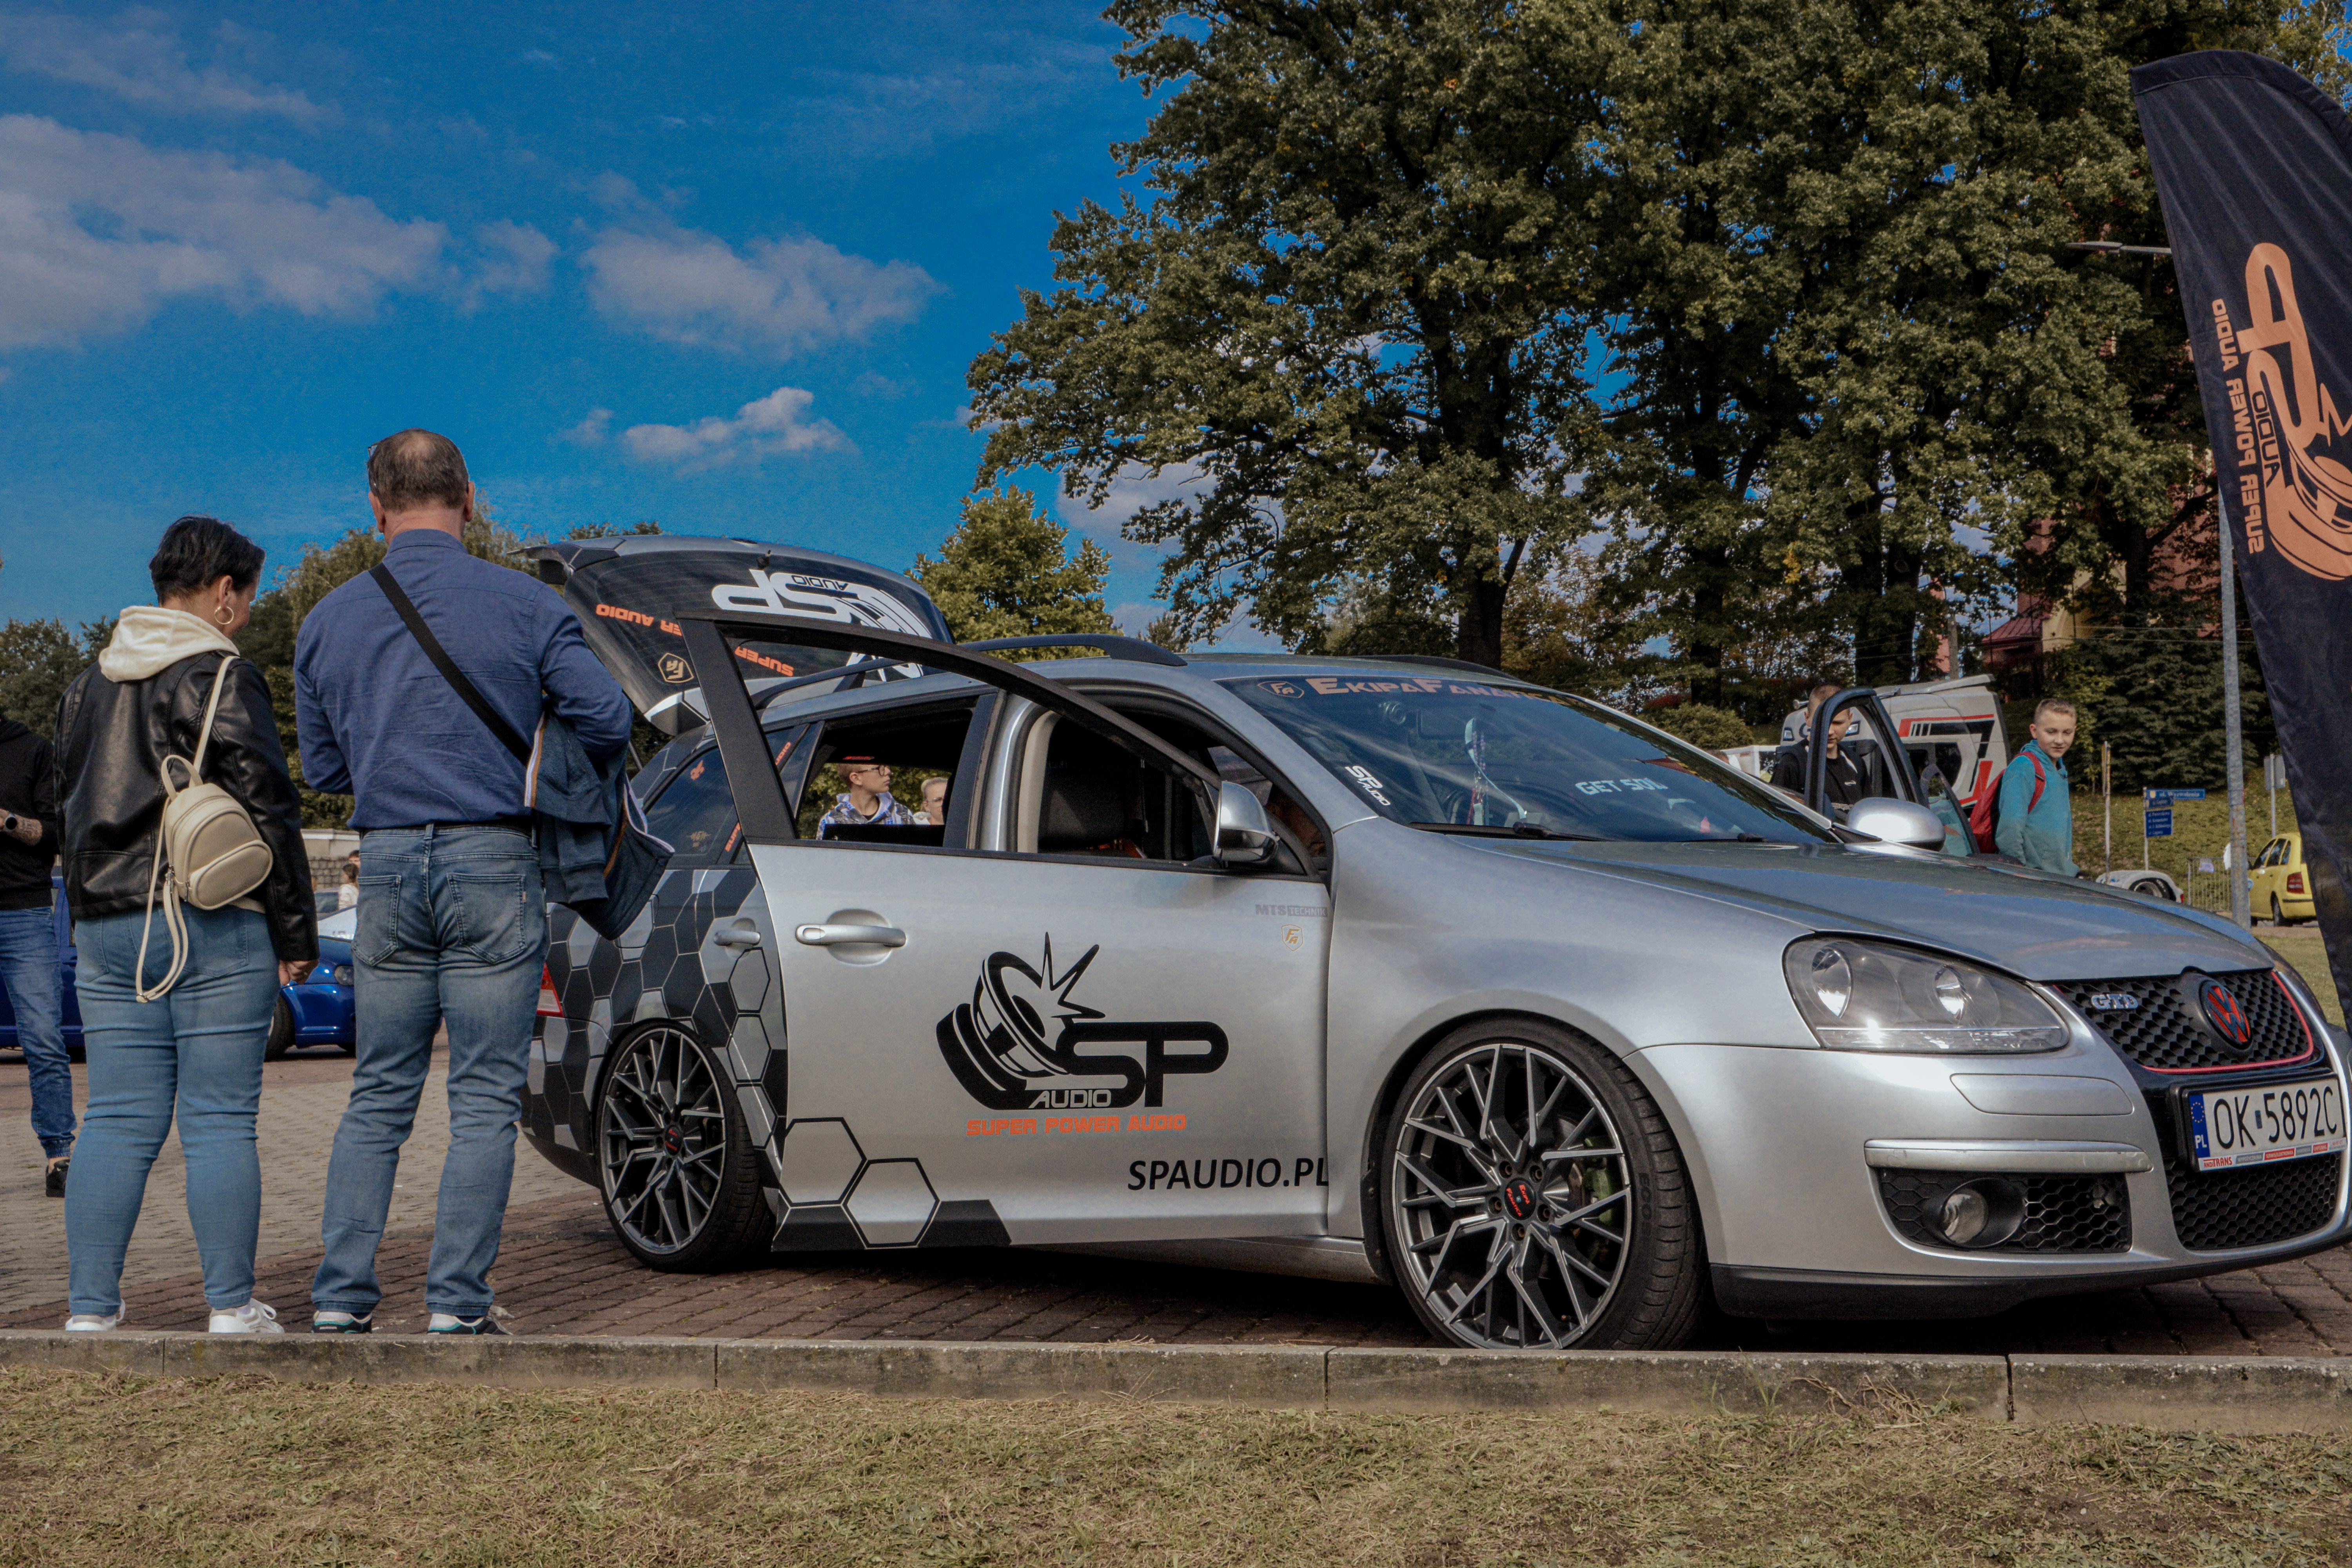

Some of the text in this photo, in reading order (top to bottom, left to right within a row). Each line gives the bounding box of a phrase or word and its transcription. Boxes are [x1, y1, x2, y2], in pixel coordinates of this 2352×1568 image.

[791, 575, 848, 591] AUDIO
[596, 604, 794, 677] SUPER AUDIO
[1345, 766, 1383, 789] SP
[1575, 780, 1622, 795] GET
[1357, 780, 1391, 806] AUDIO
[1255, 904, 1326, 916] MTS TECHNIK
[2091, 993, 2139, 1009] GTD
[1054, 1021, 1229, 1110] SP
[1028, 1089, 1111, 1109] AUDIO
[967, 1114, 1187, 1136] SUPER POWER AUDIO
[2213, 1086, 2337, 1149] OK 5892C
[2195, 1134, 2207, 1149] PL
[1127, 1158, 1329, 1191] SPAUDIO.PL
